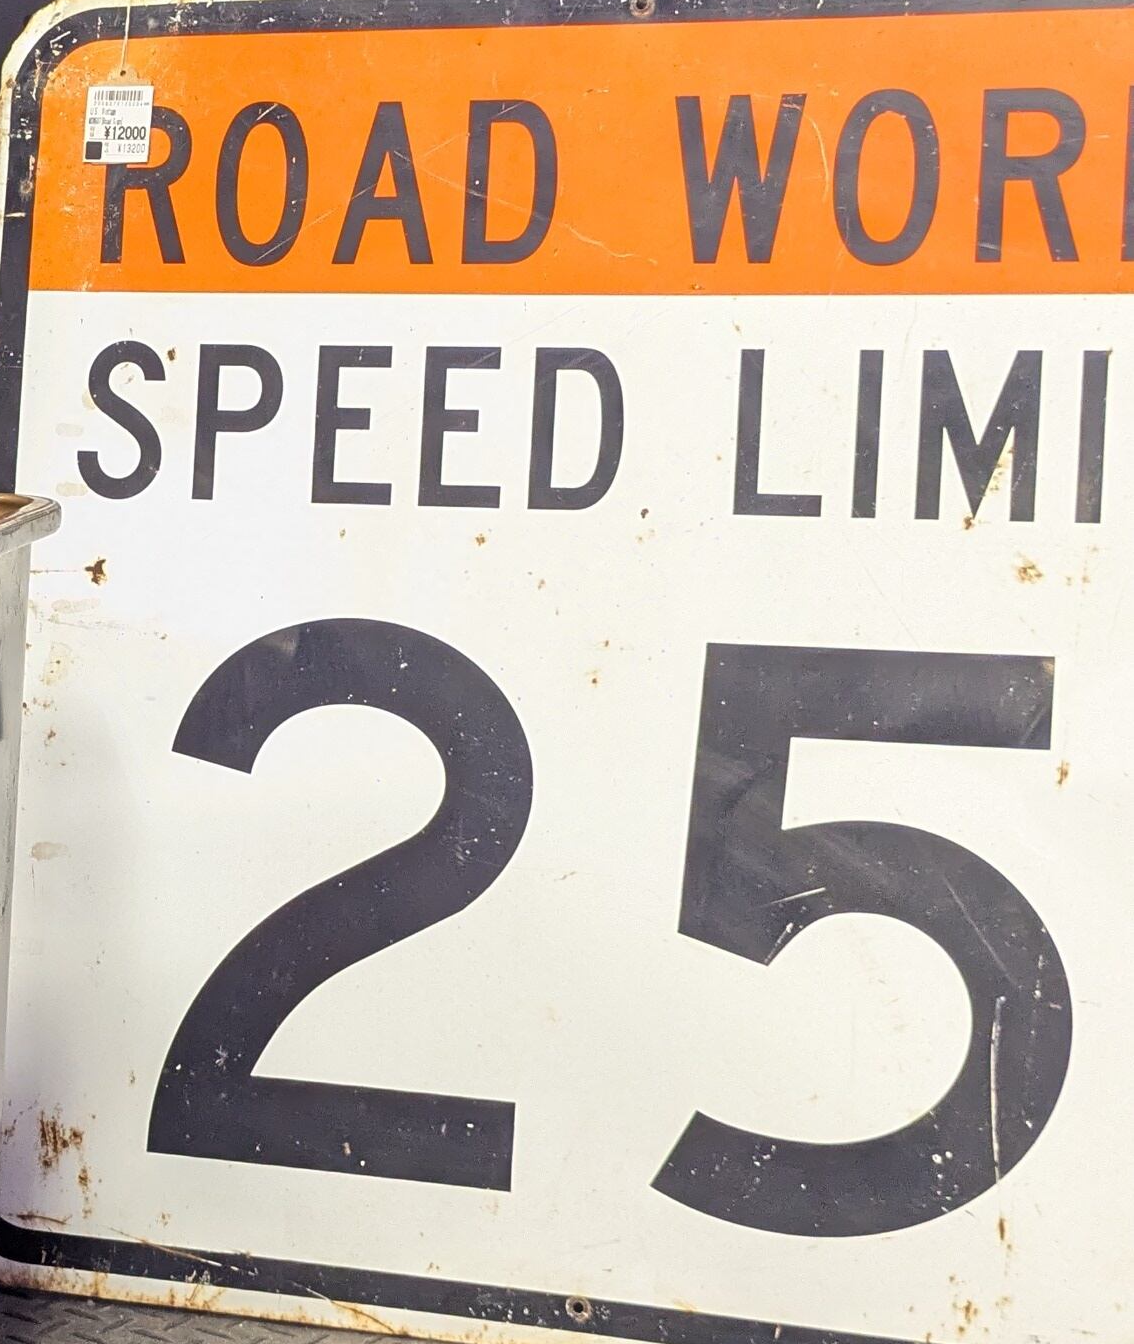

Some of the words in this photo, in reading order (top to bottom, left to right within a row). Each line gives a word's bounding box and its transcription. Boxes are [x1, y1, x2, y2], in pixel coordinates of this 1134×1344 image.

[100, 100, 560, 267] ROAD
[676, 88, 1134, 267] WOR
[104, 125, 147, 141] ¥12000
[76, 339, 625, 512] SPEED
[147, 616, 1074, 1239] 25
